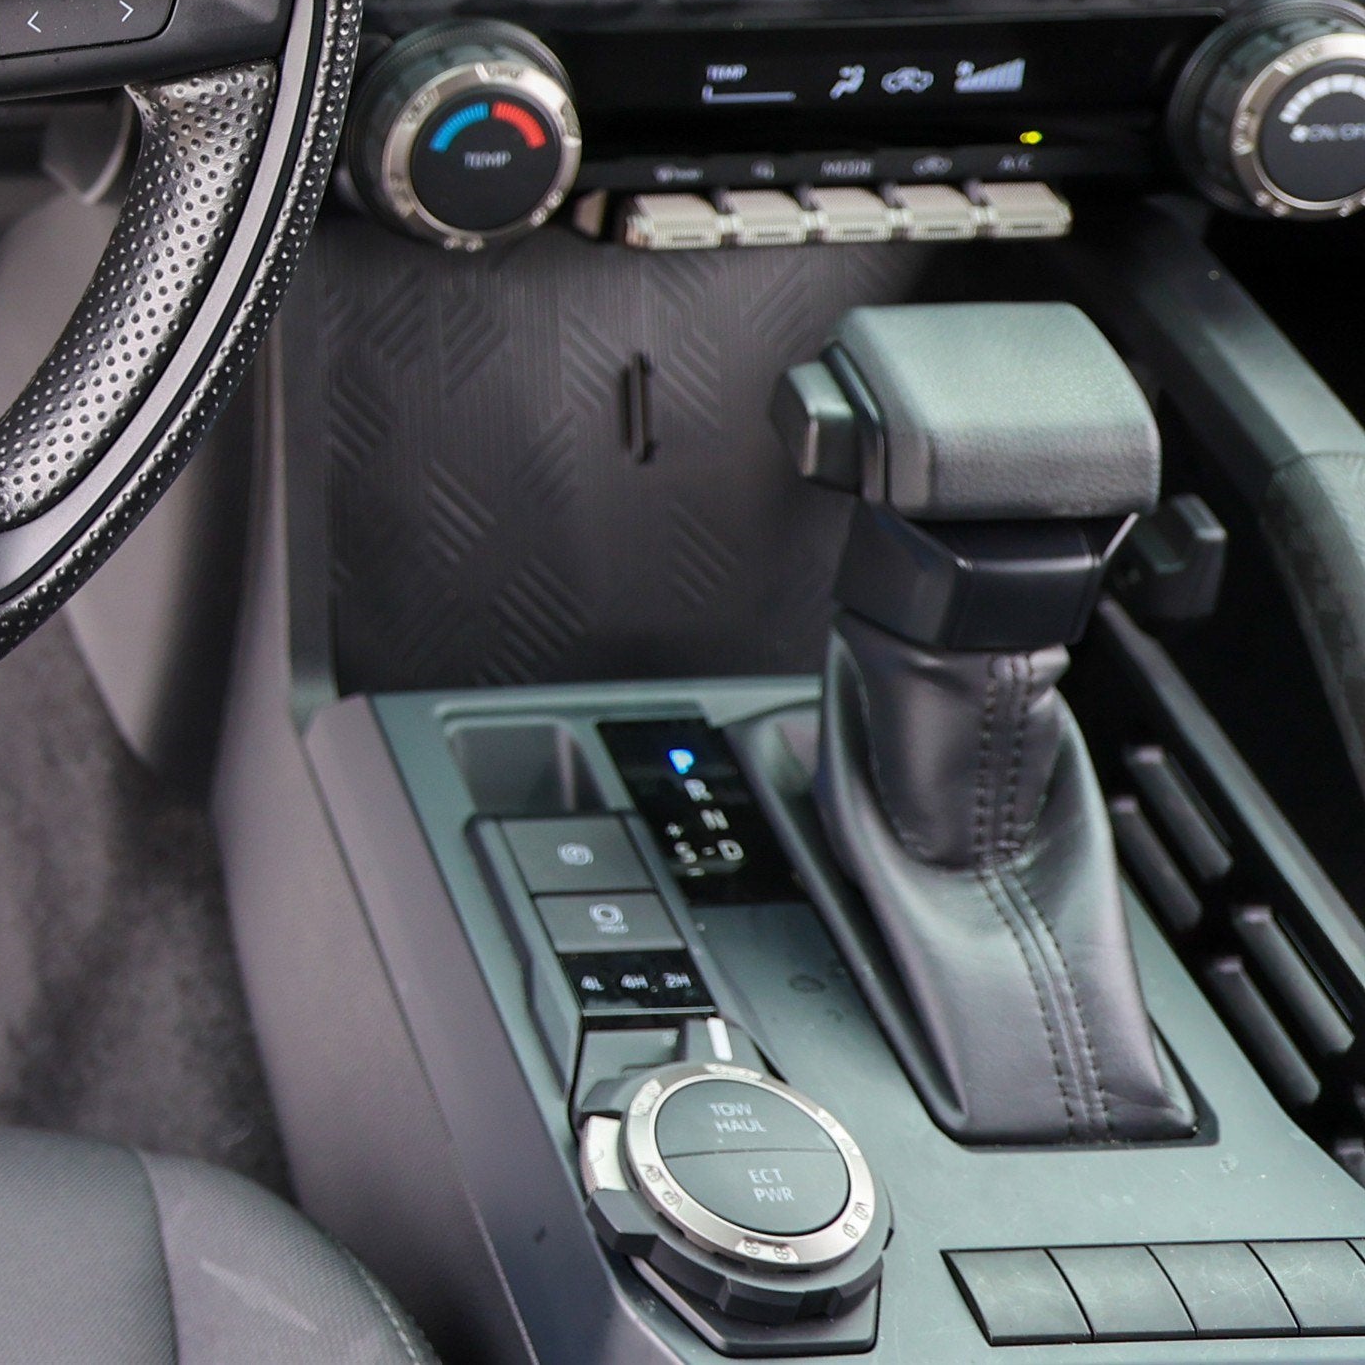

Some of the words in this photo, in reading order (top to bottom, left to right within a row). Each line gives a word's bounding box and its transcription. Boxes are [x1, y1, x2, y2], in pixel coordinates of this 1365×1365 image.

[464, 150, 511, 169] TEMP
[683, 778, 713, 802] R
[700, 808, 729, 831] N
[674, 841, 697, 864] S
[717, 839, 744, 862] D
[662, 972, 692, 989] 2H
[709, 1102, 754, 1116] TOW
[715, 1119, 767, 1134] HAUL
[747, 1168, 785, 1184] ECT
[752, 1186, 796, 1203] PWR
